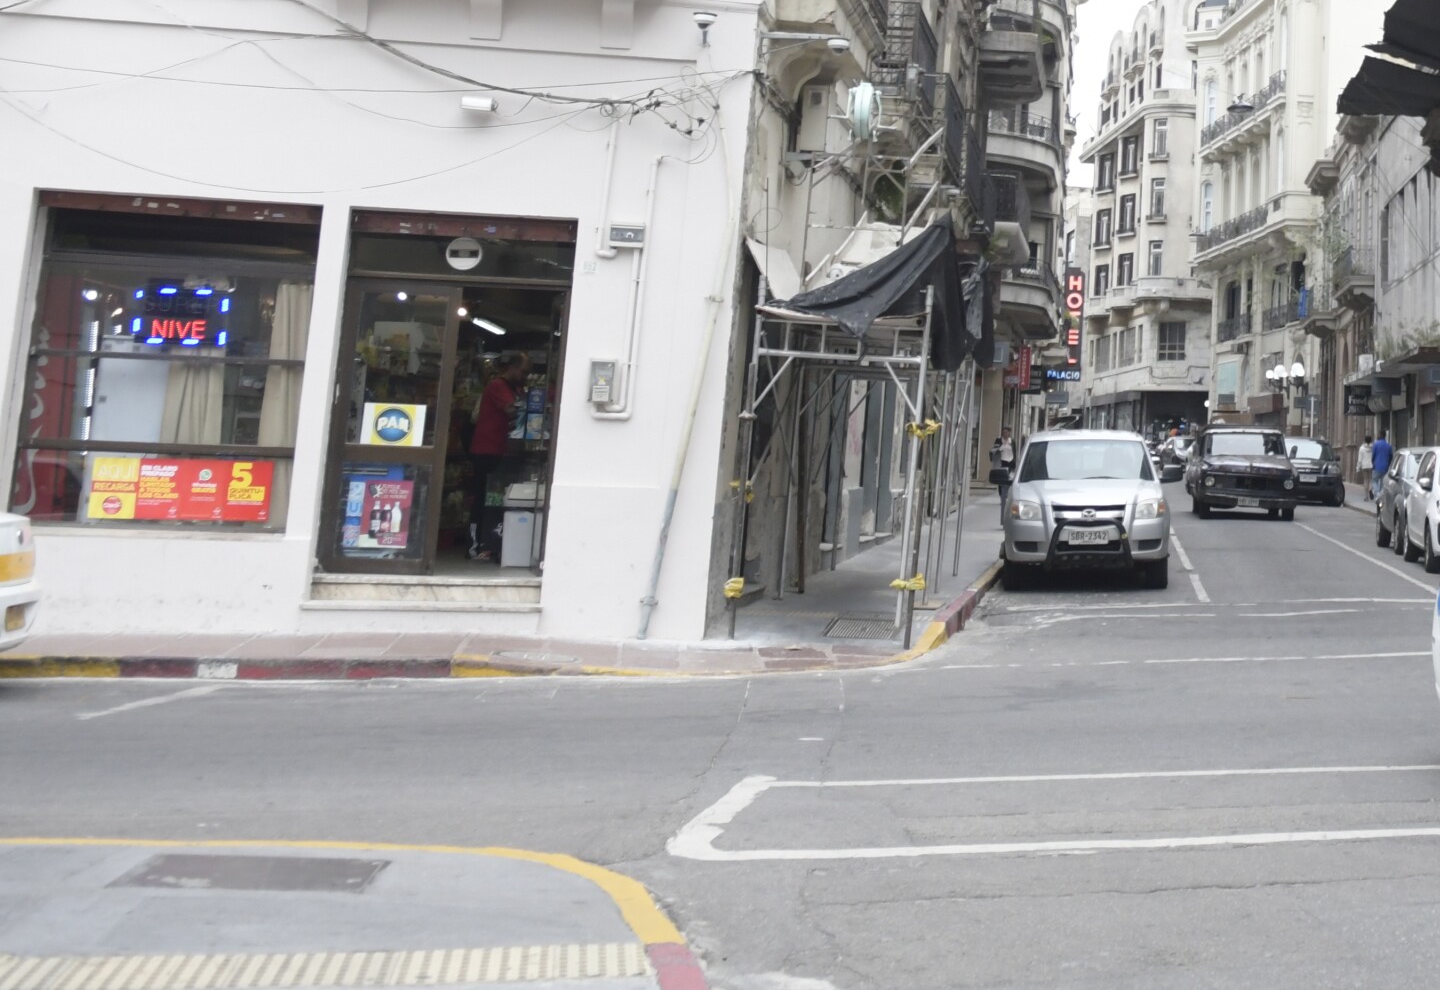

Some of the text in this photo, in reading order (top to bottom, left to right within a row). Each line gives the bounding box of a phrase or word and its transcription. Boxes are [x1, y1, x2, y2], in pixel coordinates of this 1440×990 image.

[151, 318, 207, 340] NIVE
[1046, 370, 1081, 381] PALACIO
[229, 462, 253, 488] 5
[93, 482, 136, 492] RECARGA
